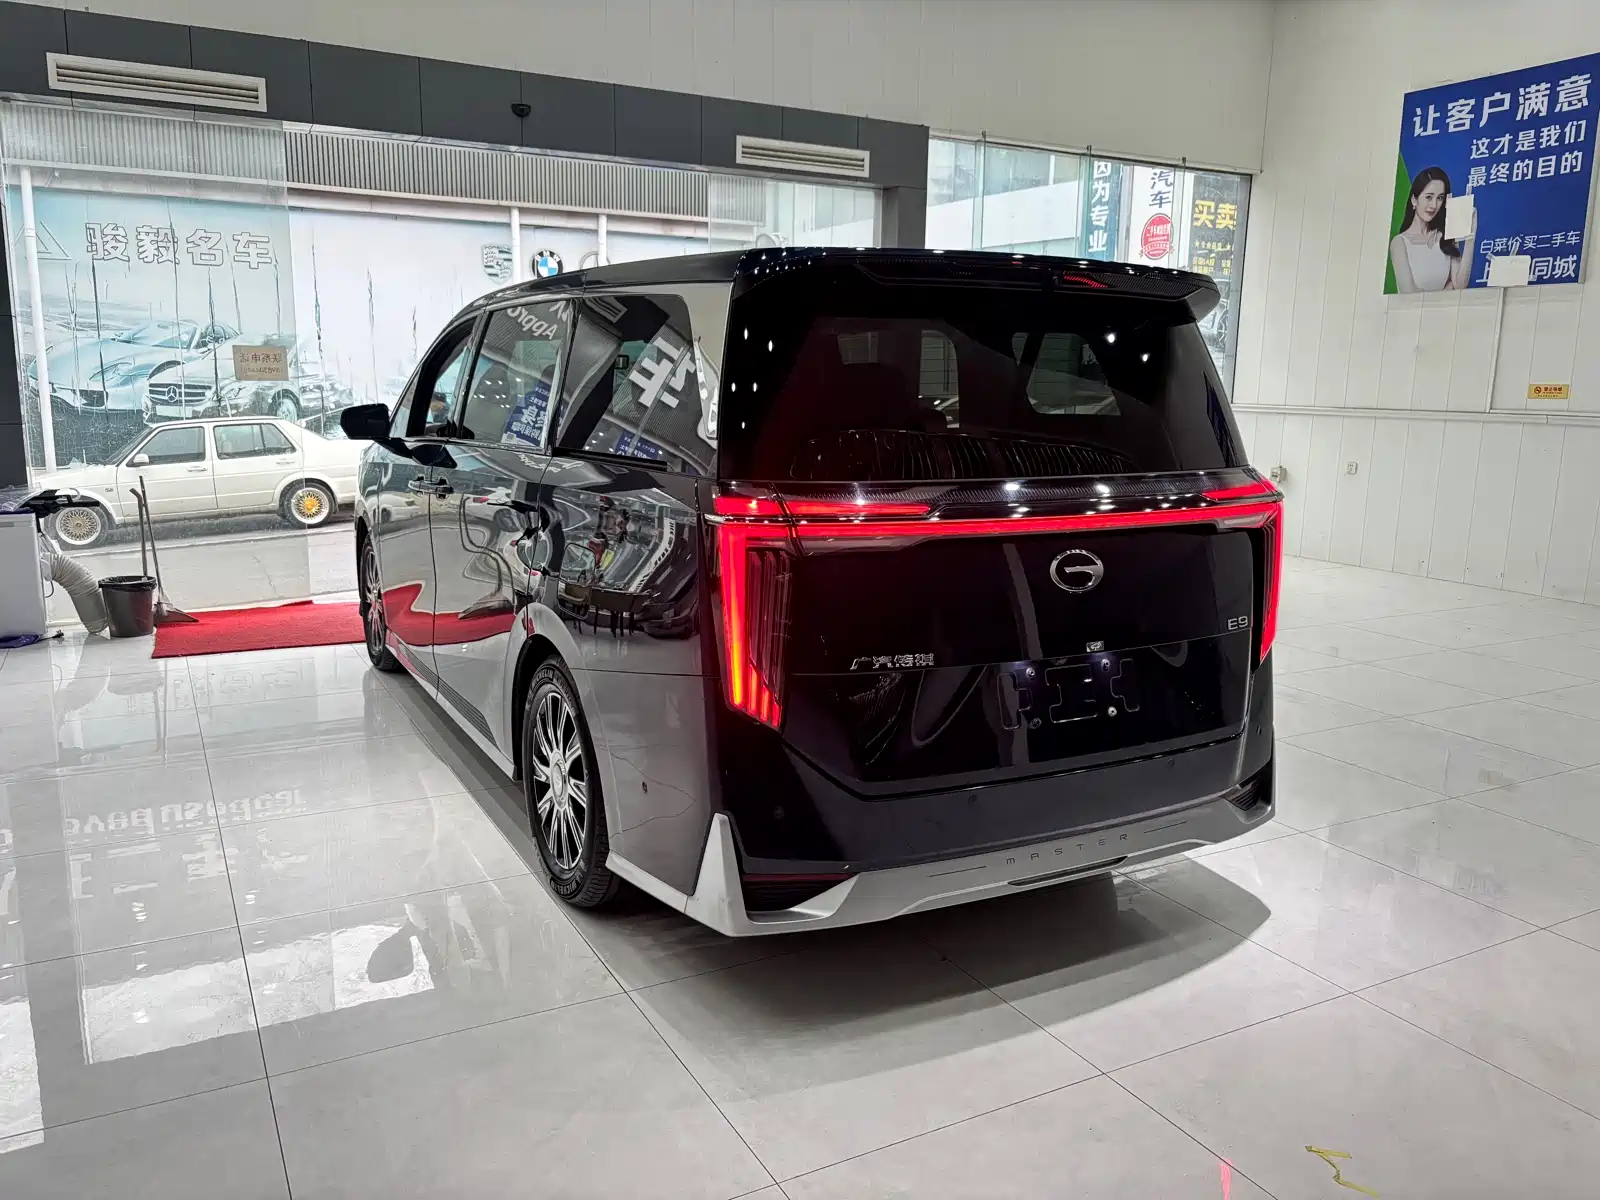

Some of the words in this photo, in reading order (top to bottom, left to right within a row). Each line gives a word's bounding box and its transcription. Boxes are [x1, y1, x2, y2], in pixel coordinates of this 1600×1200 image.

[1412, 73, 1592, 138] 让客户满意
[1470, 120, 1587, 160] 这才是我们
[1468, 151, 1584, 188] 最终的目的
[1088, 160, 1112, 253] 因为专业
[1149, 170, 1174, 209] 汽车
[1193, 200, 1238, 230] 买卖
[85, 222, 273, 270] 骏毅名车
[1476, 254, 1578, 283] 上同城
[1227, 615, 1249, 630] E9
[849, 652, 936, 671] 广汽传祺
[1005, 833, 1129, 865] MASTER
